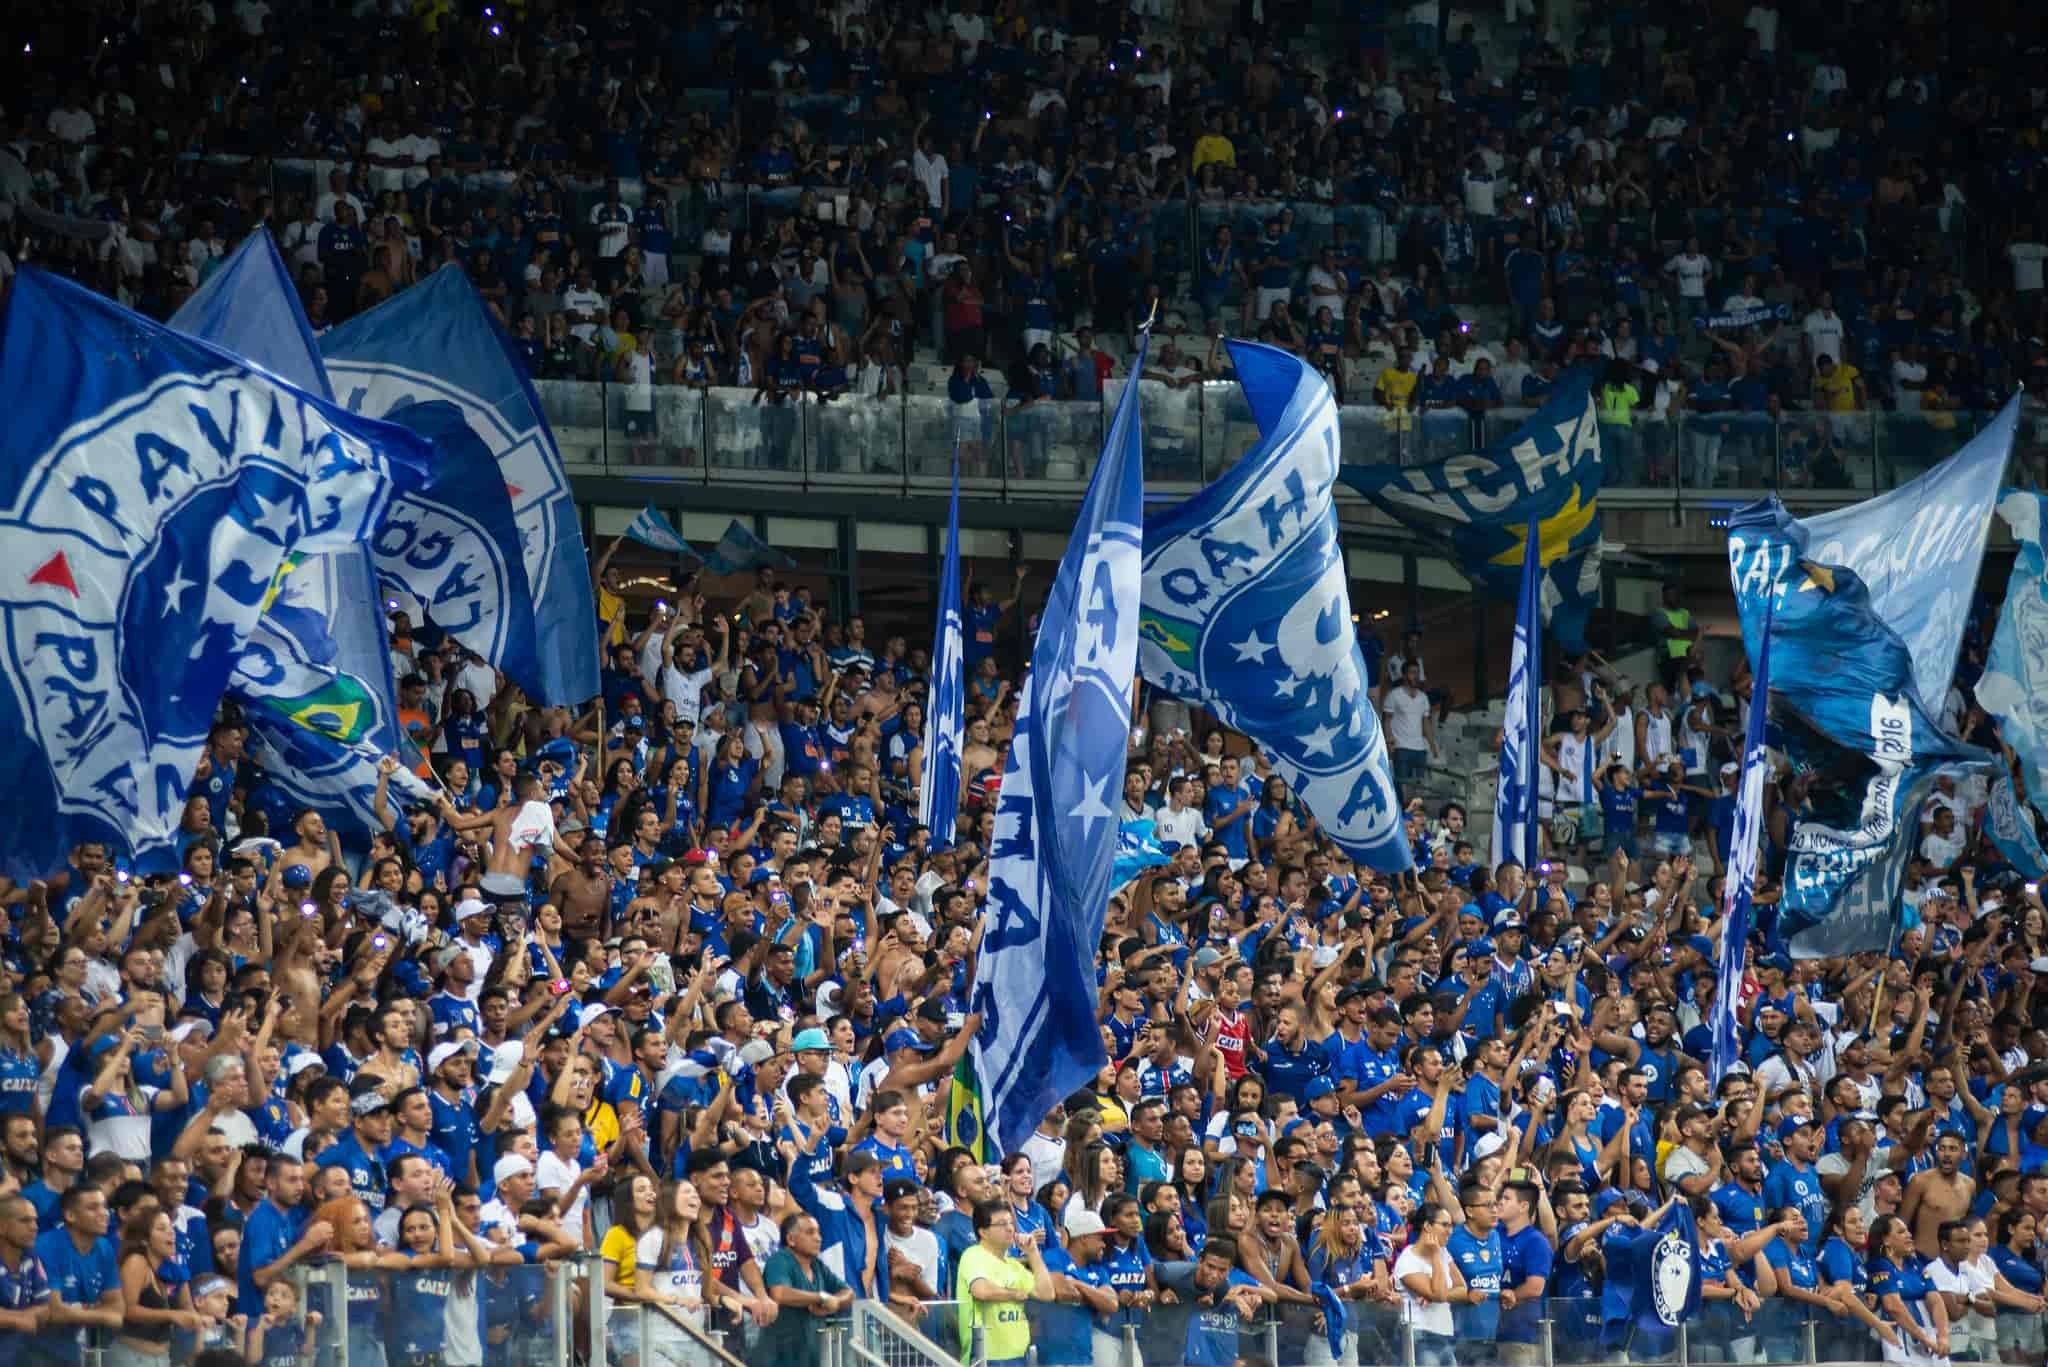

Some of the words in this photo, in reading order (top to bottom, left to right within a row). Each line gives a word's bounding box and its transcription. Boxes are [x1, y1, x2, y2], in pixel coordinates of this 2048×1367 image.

[353, 1168, 368, 1186] 30
[1111, 1272, 1146, 1285] CAIXA
[998, 1310, 1022, 1323] CAI
